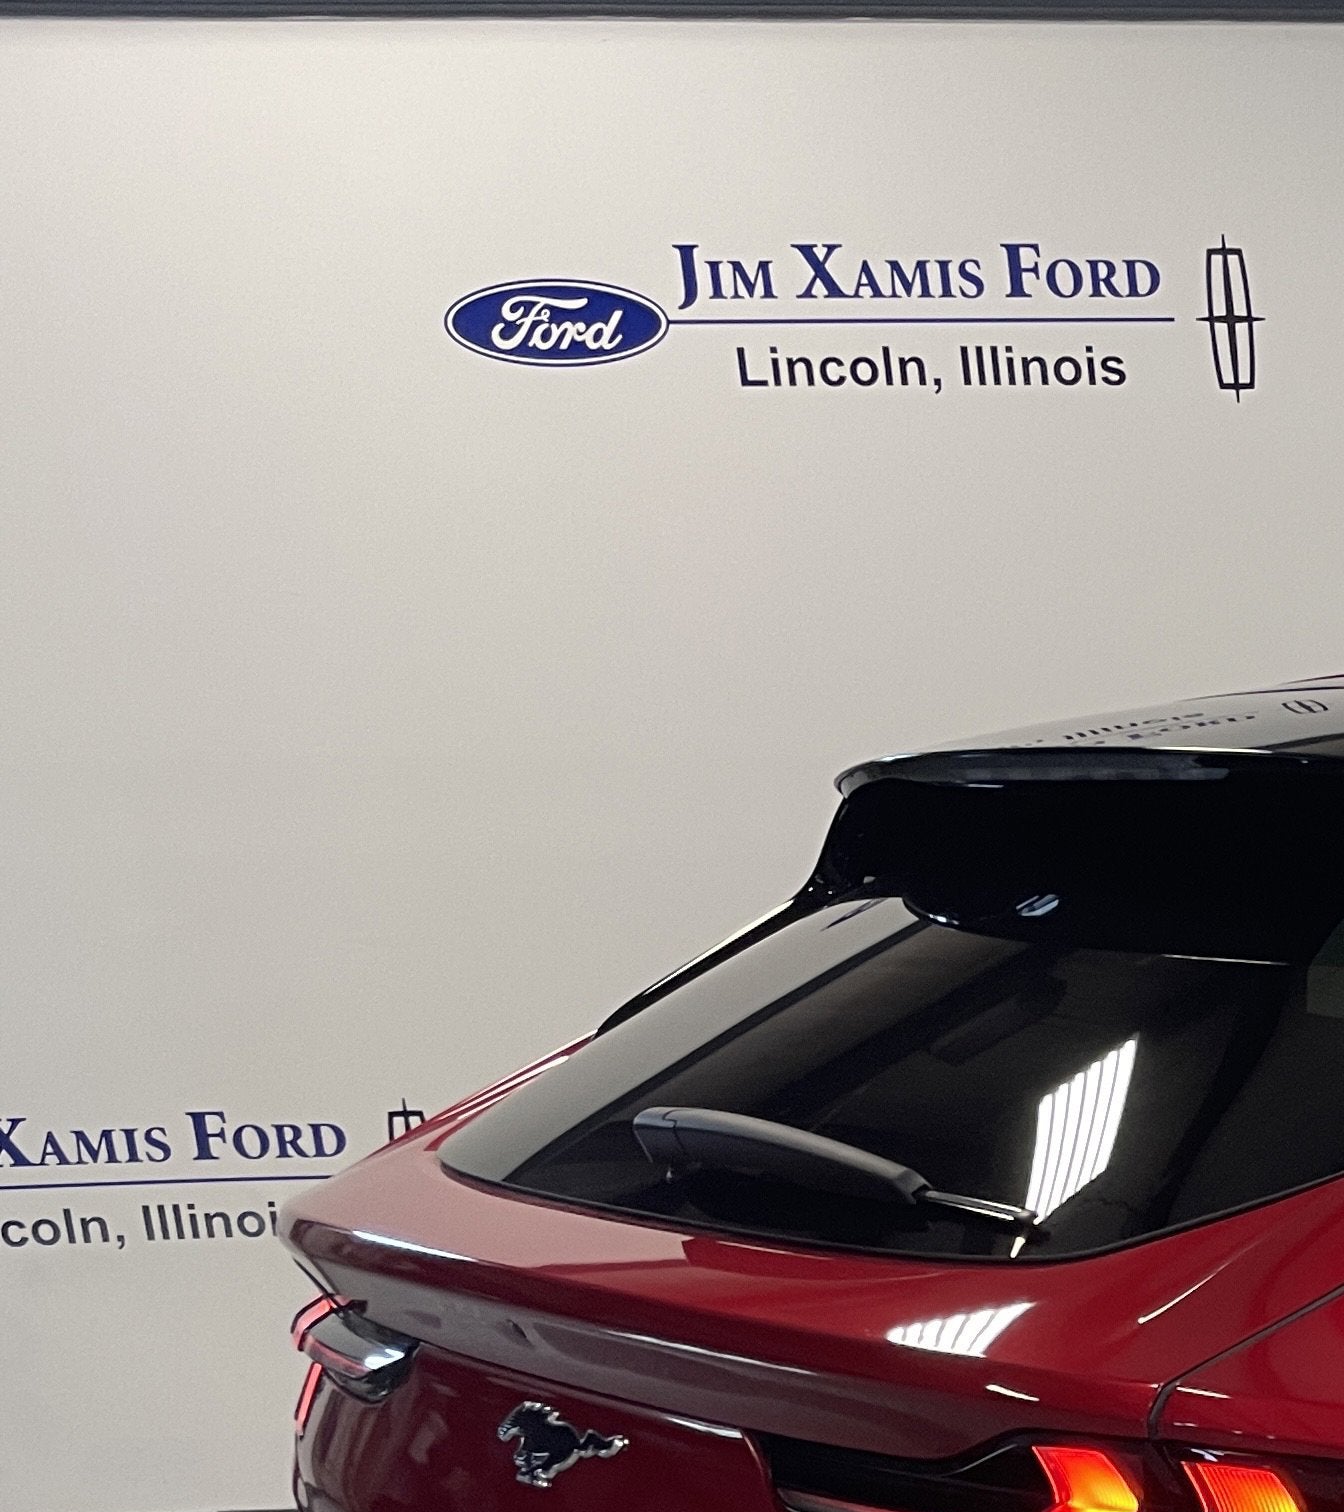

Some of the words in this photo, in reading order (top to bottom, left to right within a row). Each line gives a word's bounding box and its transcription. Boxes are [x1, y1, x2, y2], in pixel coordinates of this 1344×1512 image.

[672, 244, 774, 310] JIM
[791, 243, 984, 299] XAMIS
[1000, 243, 1161, 299] FORD
[491, 295, 624, 353] Ford
[737, 345, 942, 395] Lincoln,
[960, 345, 1127, 387] Illinois
[185, 1111, 347, 1161] FORD
[1, 1208, 125, 1250] coln,
[142, 1200, 278, 1242] Illinoi
